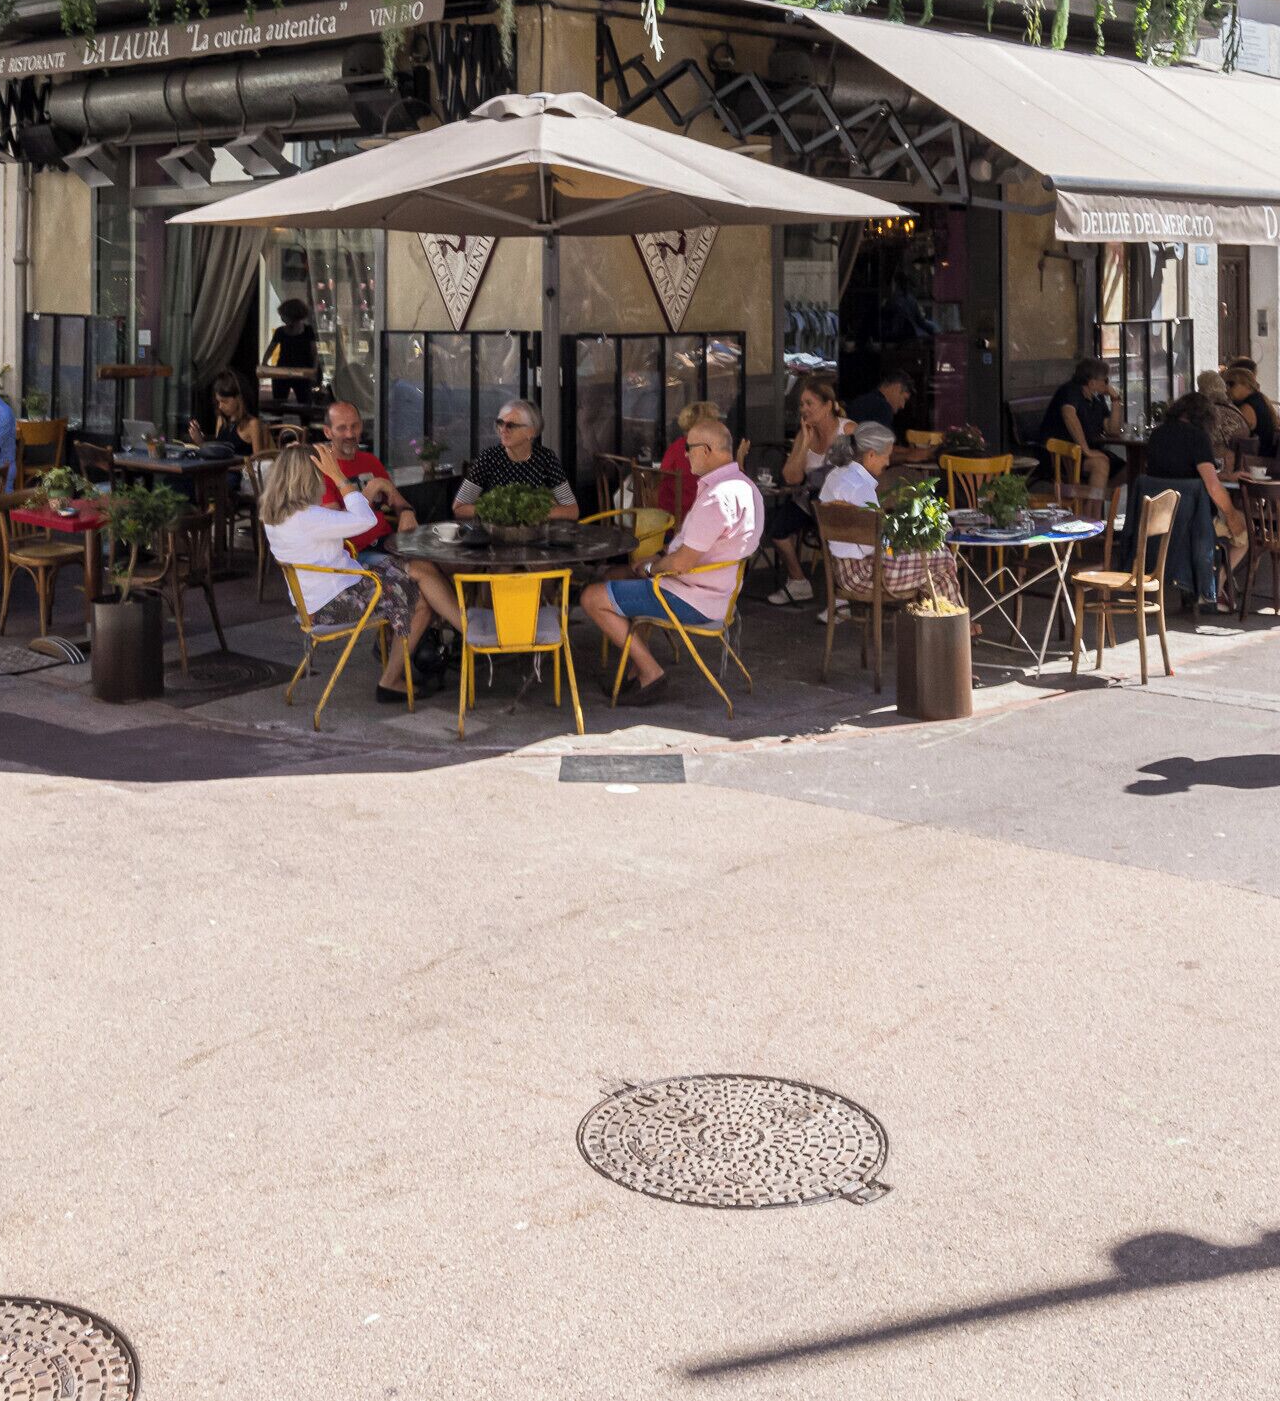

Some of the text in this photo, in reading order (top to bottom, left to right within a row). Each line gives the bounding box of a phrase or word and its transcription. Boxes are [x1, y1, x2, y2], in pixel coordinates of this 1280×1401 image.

[8, 52, 67, 73] RISTORANTE
[82, 38, 106, 65] DA
[110, 29, 169, 61] LAURA
[214, 24, 261, 48] cucina
[1081, 210, 1130, 235] DELIZIE
[1134, 212, 1161, 235] DEL
[1162, 215, 1214, 237] MERCATO
[428, 240, 456, 304] CUCINA
[646, 243, 675, 305] CUCINA
